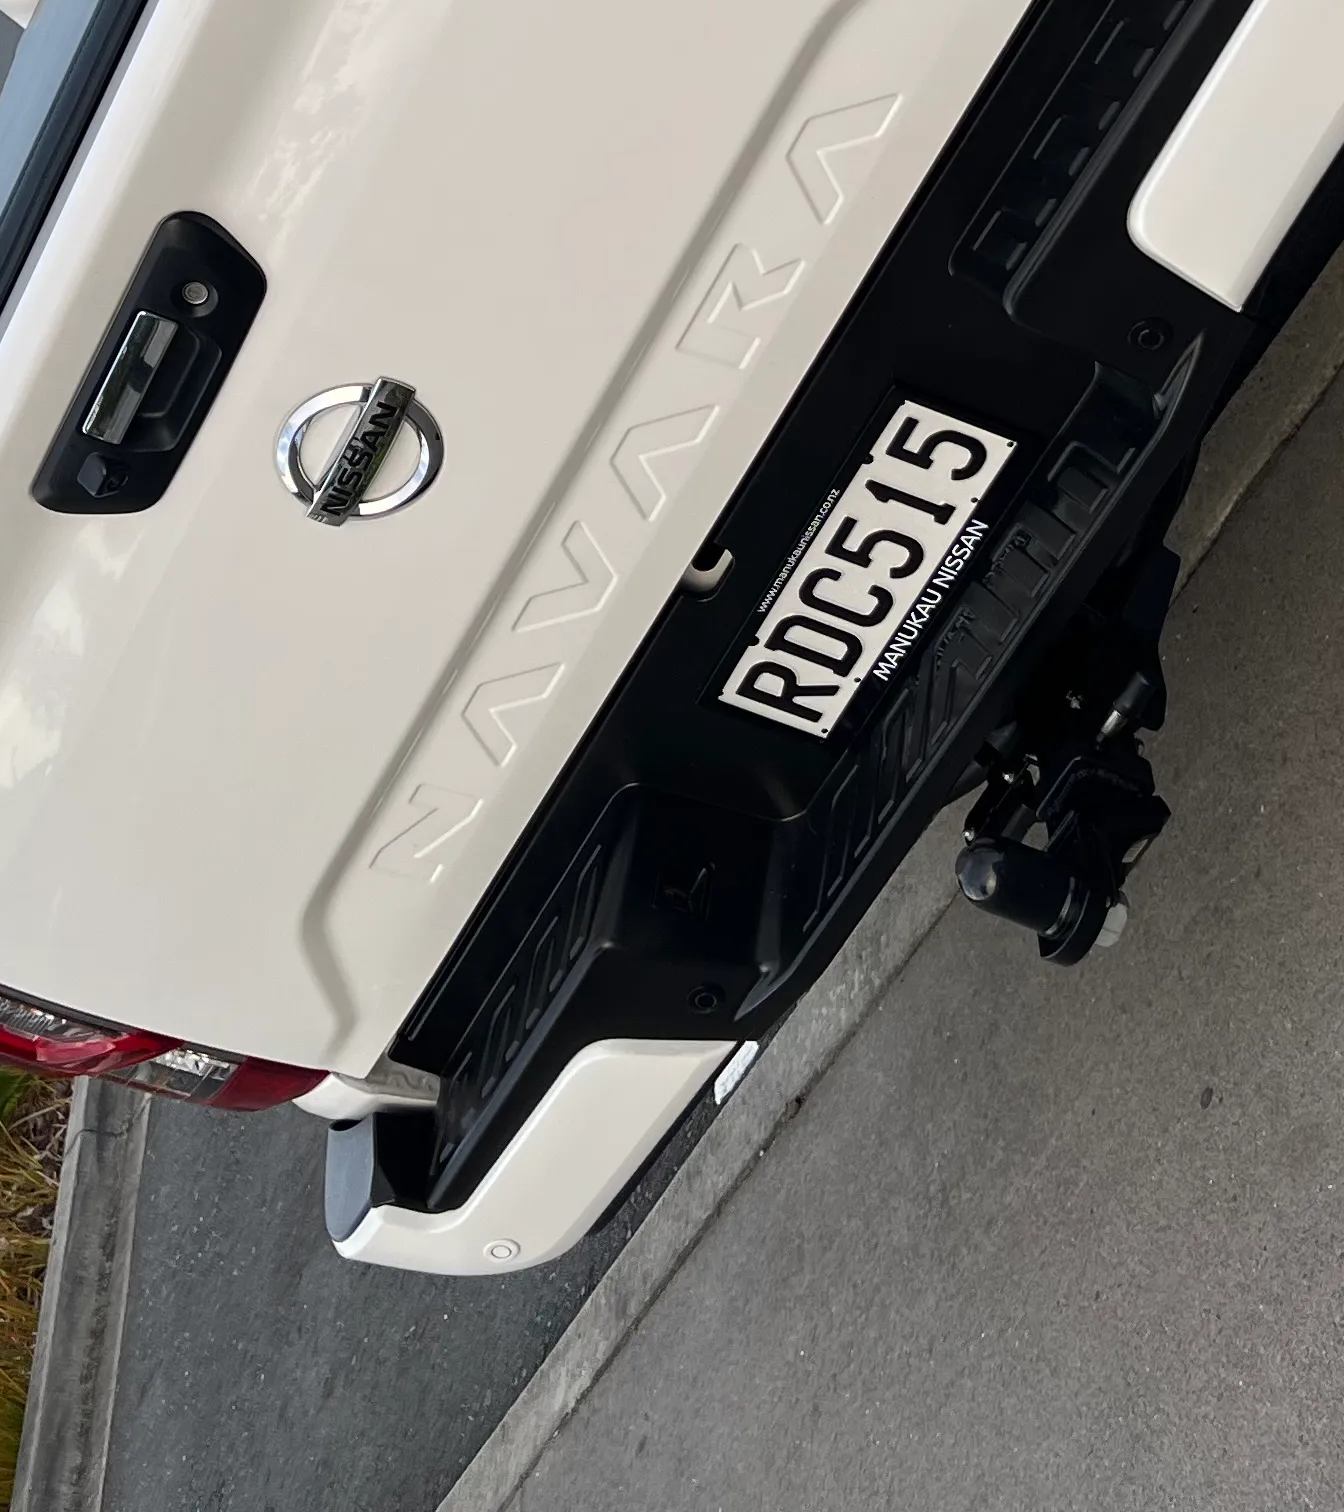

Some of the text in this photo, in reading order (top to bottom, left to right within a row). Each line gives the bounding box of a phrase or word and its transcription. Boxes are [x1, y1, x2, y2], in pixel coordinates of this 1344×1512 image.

[320, 400, 399, 517] NISSAN
[369, 91, 904, 884] NAVARA
[735, 416, 988, 723] RDC515
[757, 488, 841, 613] www.manukaunissan.co.nz
[873, 518, 989, 681] MANUKAU NISSAN
